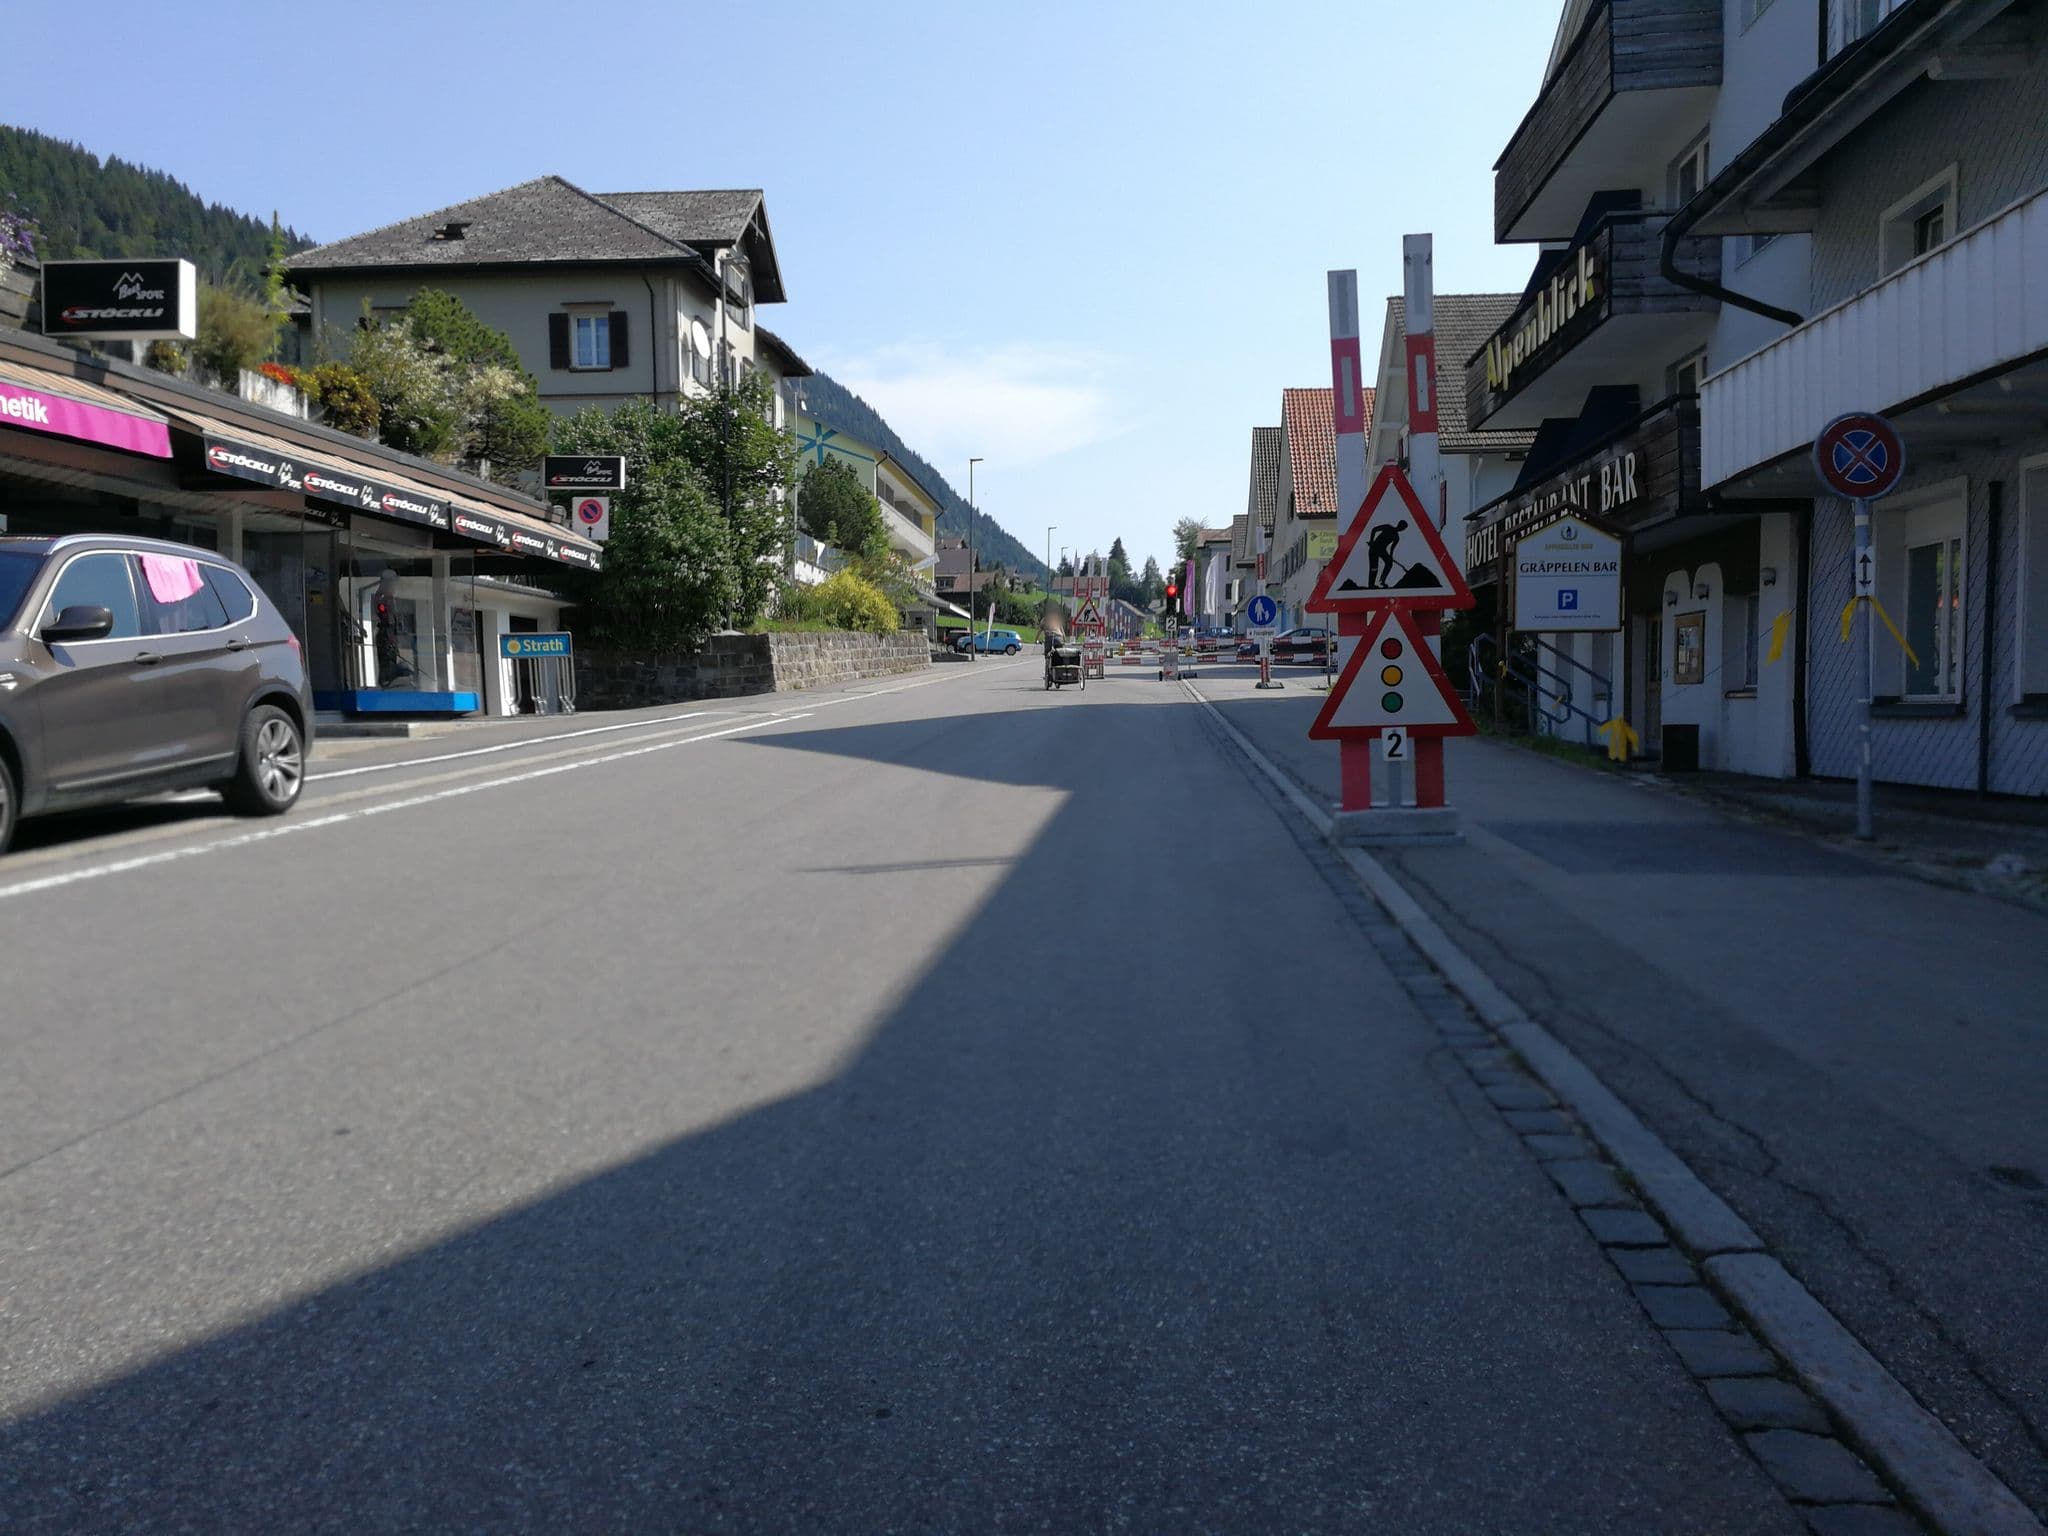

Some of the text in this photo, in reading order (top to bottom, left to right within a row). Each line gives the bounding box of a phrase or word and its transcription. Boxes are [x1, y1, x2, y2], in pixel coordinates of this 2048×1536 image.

[62, 307, 164, 319] STÖCKLI
[1487, 246, 1595, 392] Alpenblick
[209, 448, 276, 474] STÖCKLI
[304, 475, 359, 496] STÖCKLI
[382, 496, 428, 514] STÖCKLI
[1467, 523, 1499, 570] HOTEL
[1600, 452, 1638, 513] BAR
[1519, 560, 1617, 573] GRÄPPELEN BAR
[1562, 592, 1574, 608] P
[1168, 619, 1176, 630] 2
[523, 638, 564, 652] Strath
[1387, 733, 1403, 758] 2
